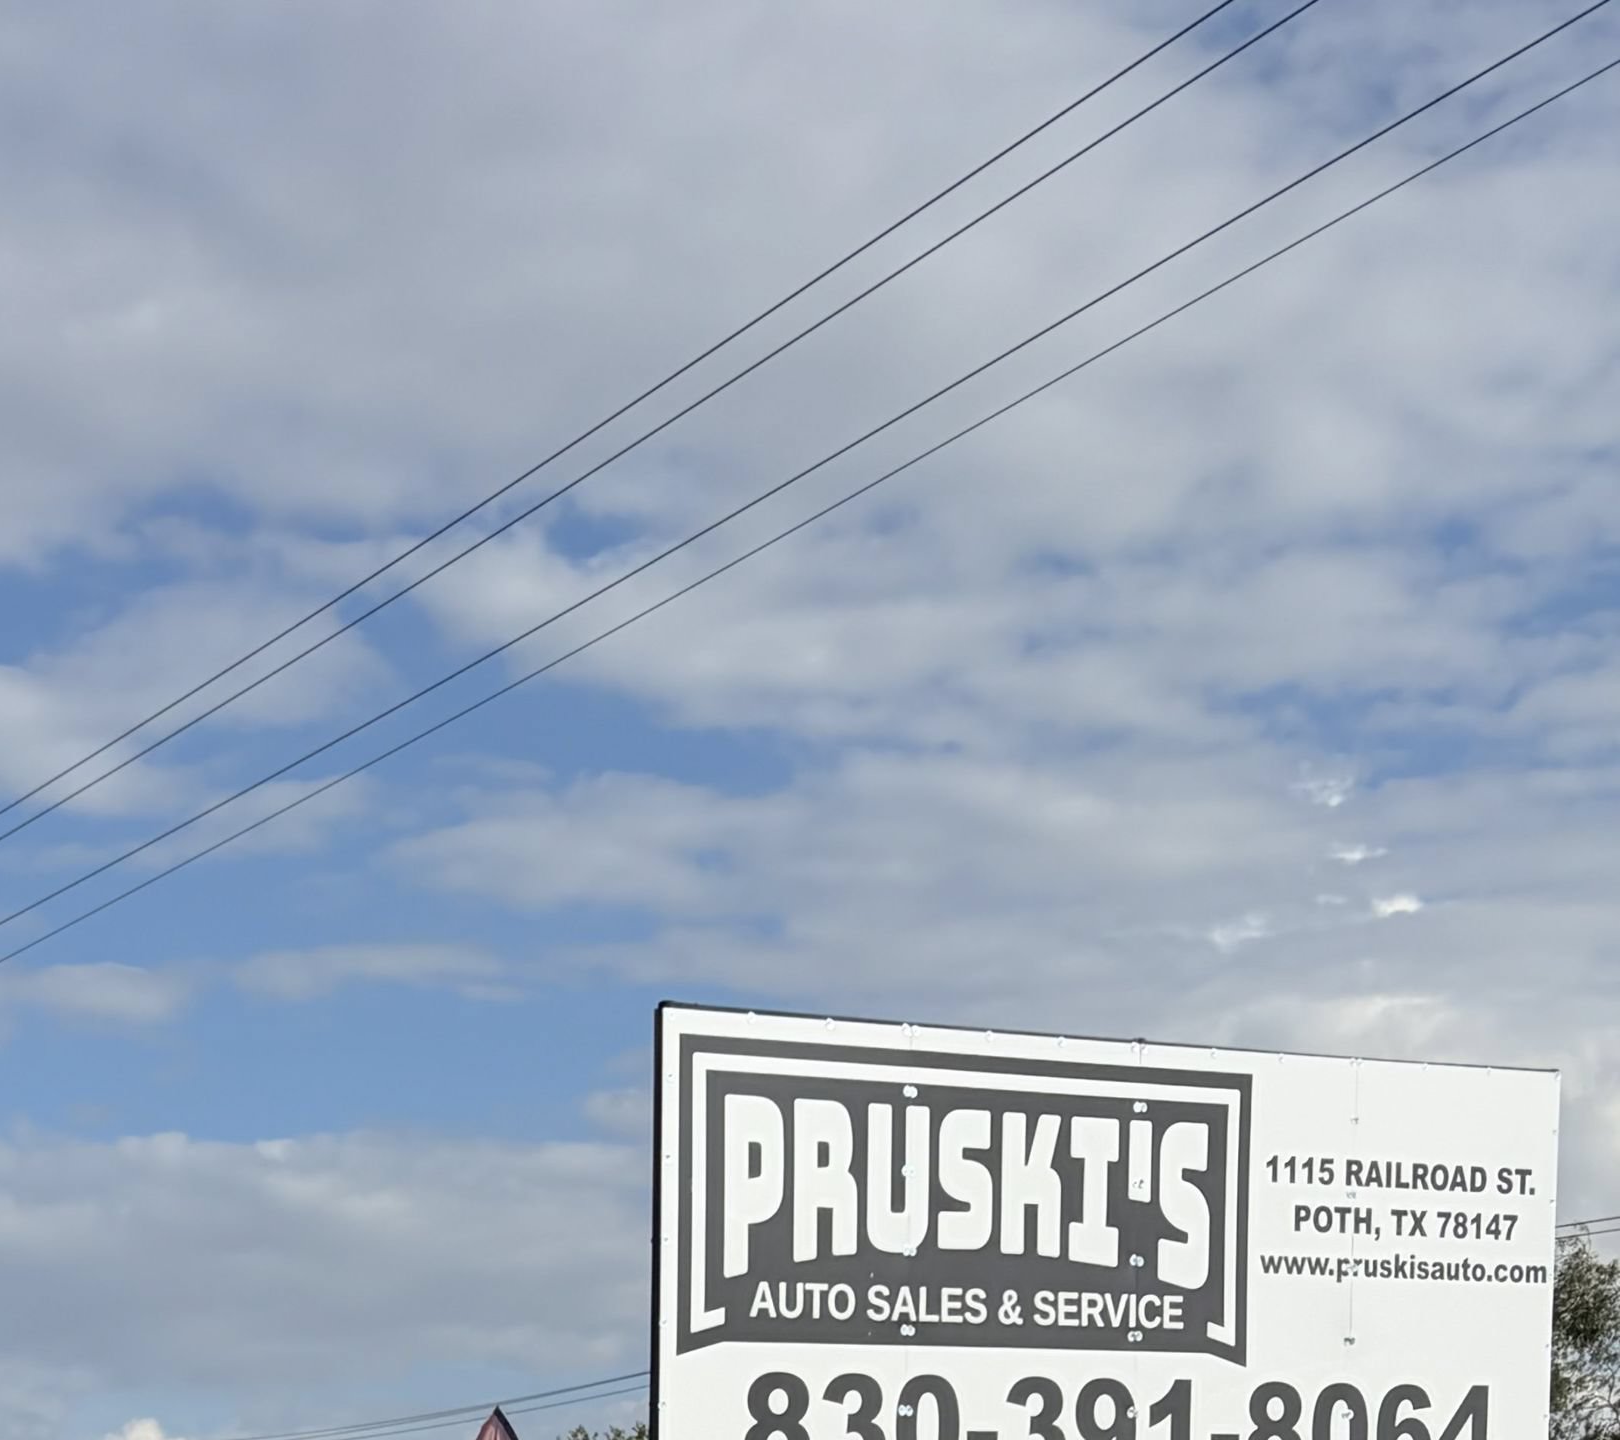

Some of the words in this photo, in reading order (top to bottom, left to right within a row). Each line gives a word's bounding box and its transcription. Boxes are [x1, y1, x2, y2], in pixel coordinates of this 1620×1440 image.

[723, 1093, 1210, 1290] PRUSKI'S
[1265, 1155, 1335, 1186] 1115
[1345, 1158, 1487, 1193] RAILROAD
[1496, 1167, 1536, 1196] ST.
[1293, 1204, 1381, 1241] POTH,
[1390, 1208, 1428, 1237] TX
[1436, 1211, 1519, 1241] 78147
[1259, 1253, 1548, 1284] www.pruskisauto.com
[748, 1281, 857, 1320] AUTO
[866, 1285, 988, 1324] SALES
[997, 1289, 1025, 1326] &
[1032, 1291, 1185, 1330] SERVICE
